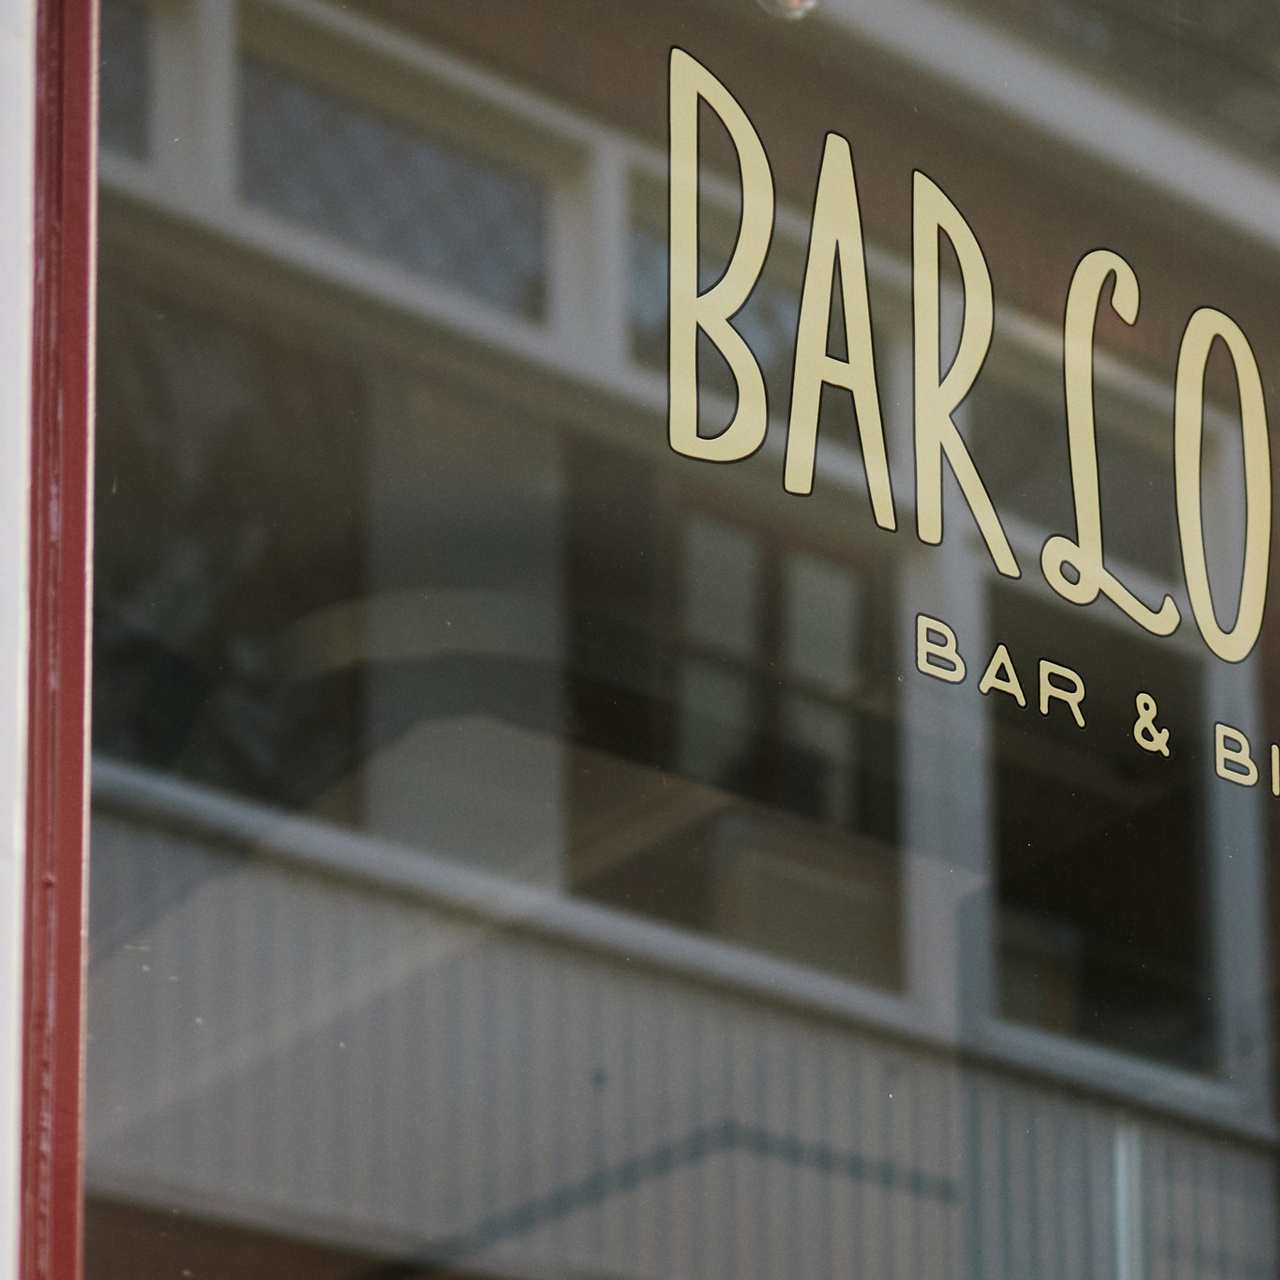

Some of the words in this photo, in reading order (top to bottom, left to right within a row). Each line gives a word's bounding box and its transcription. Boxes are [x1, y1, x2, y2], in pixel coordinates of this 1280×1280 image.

[668, 47, 1021, 579] BAR
[916, 615, 1087, 729] BAR
[1132, 692, 1171, 758] &
